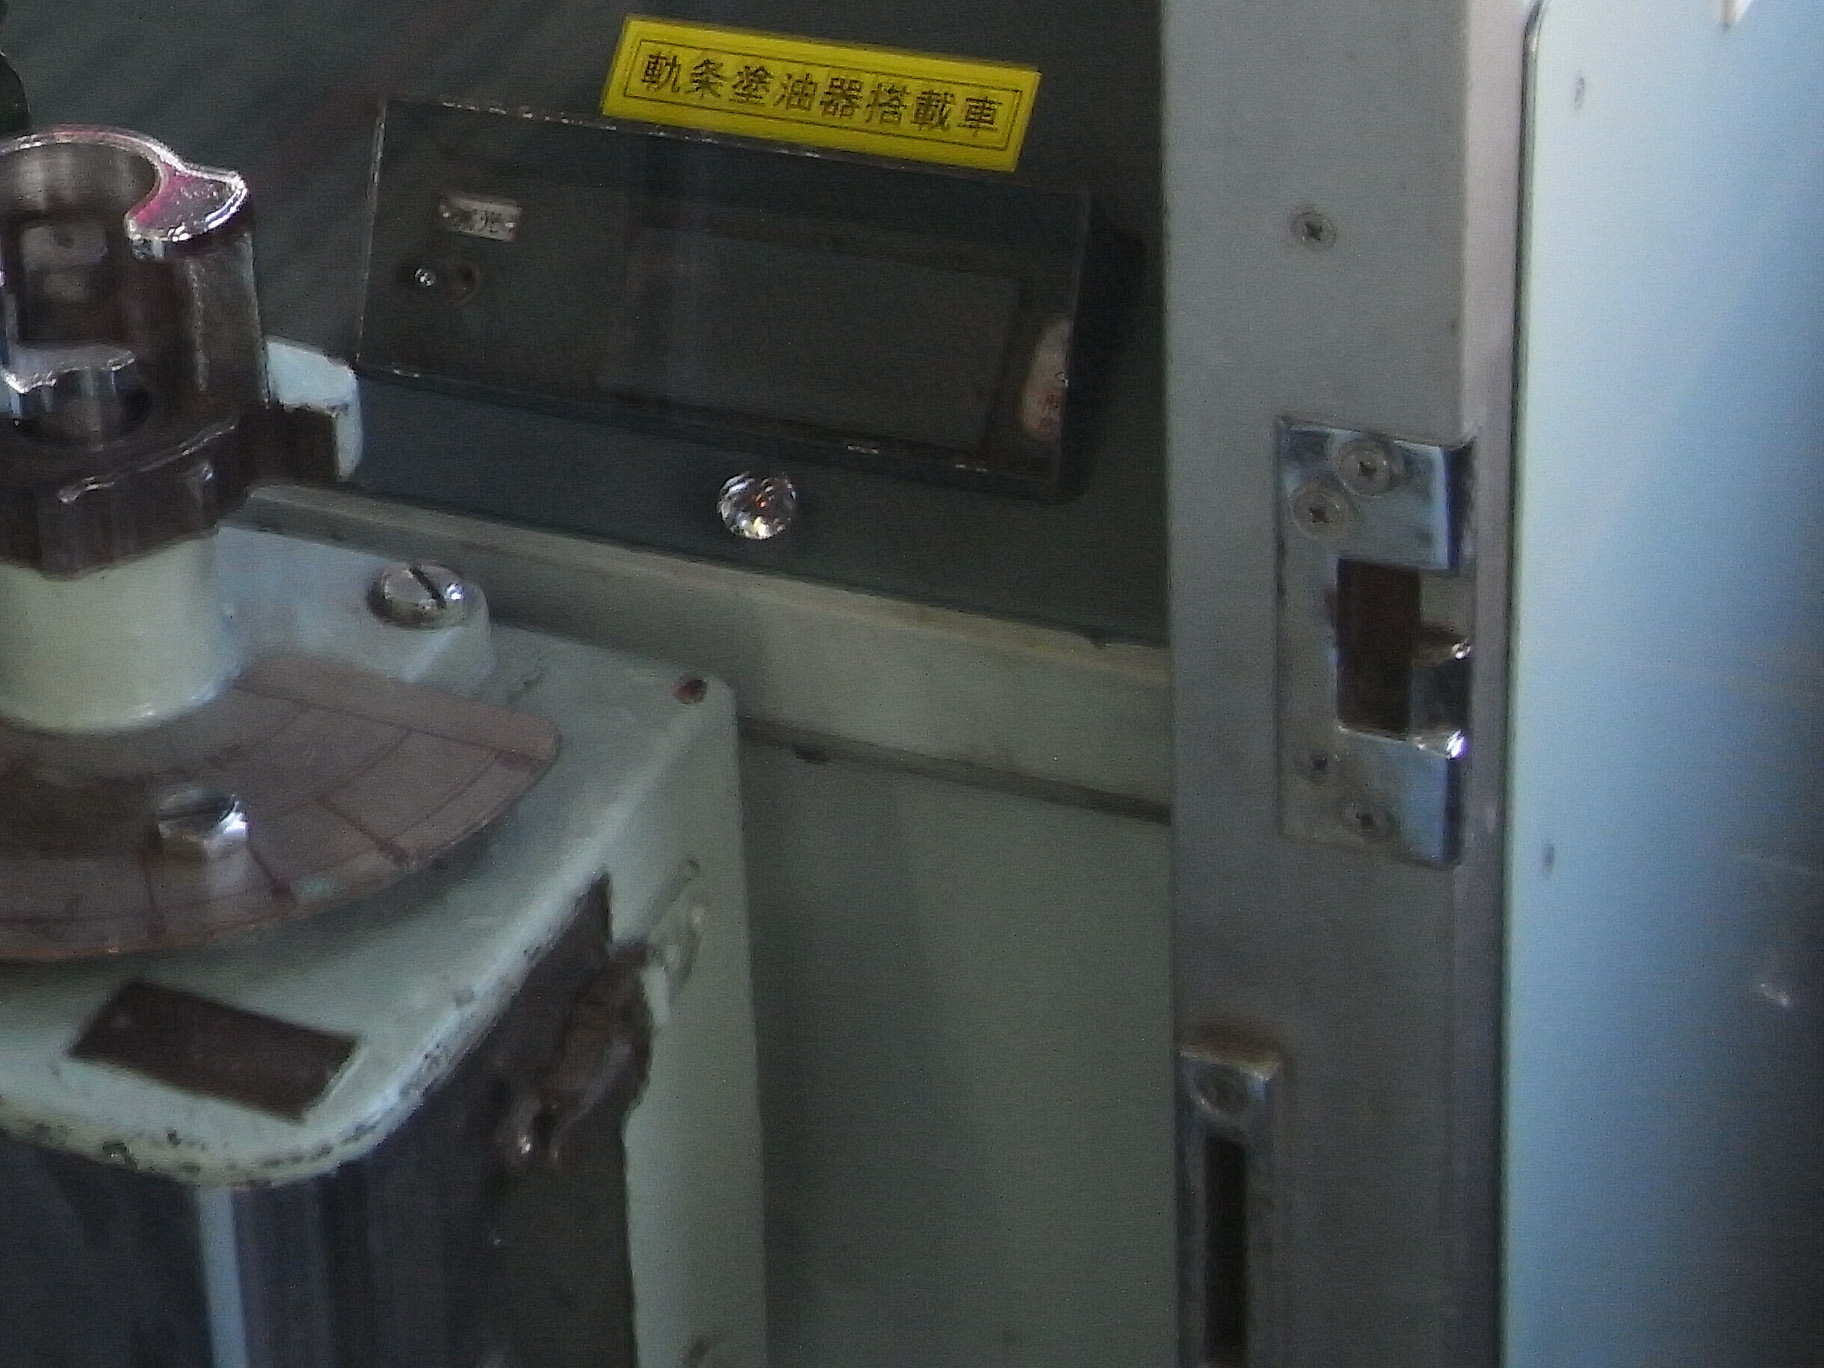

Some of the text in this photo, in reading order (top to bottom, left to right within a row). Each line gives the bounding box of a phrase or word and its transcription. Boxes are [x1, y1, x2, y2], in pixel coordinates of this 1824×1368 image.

[640, 51, 1003, 136] 軌条塗油器搭載車
